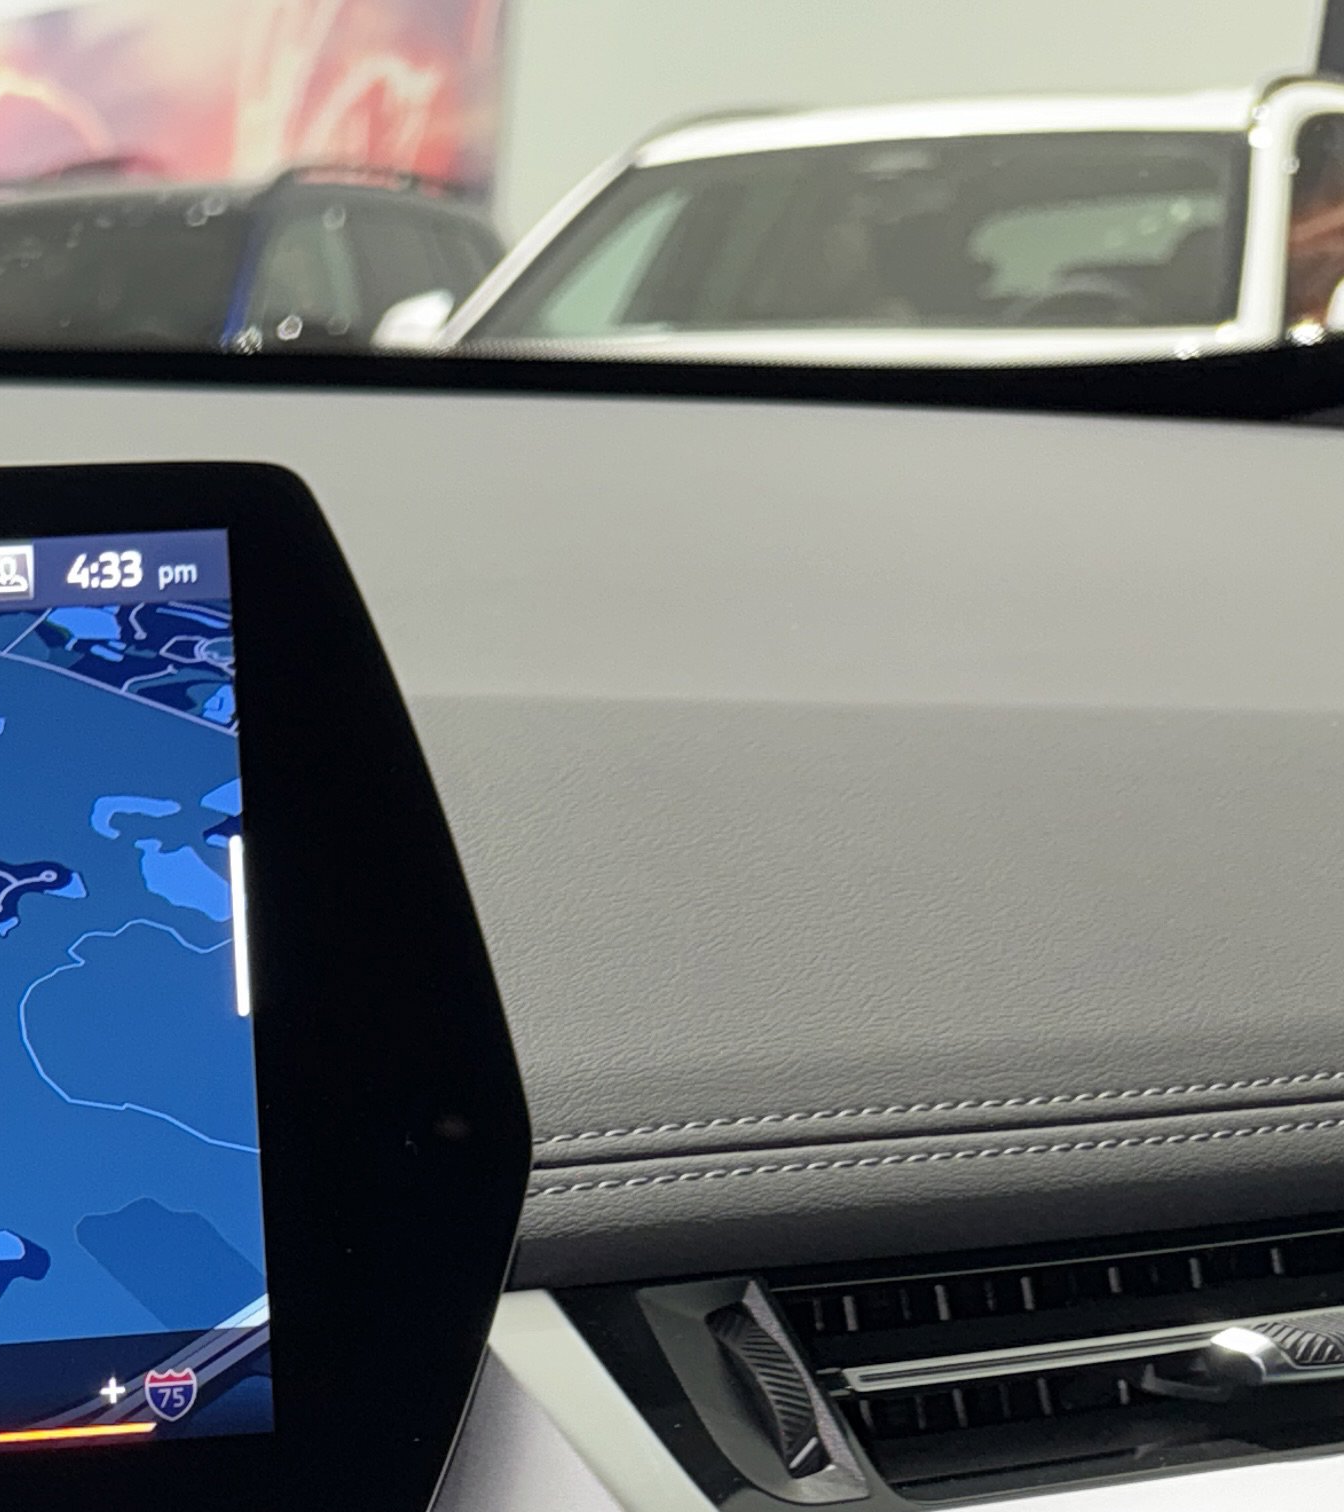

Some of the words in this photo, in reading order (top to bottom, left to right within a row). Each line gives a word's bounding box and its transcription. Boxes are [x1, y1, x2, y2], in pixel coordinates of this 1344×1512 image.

[66, 551, 143, 589] 4:33
[158, 563, 198, 591] pm
[158, 1387, 186, 1410] 75
